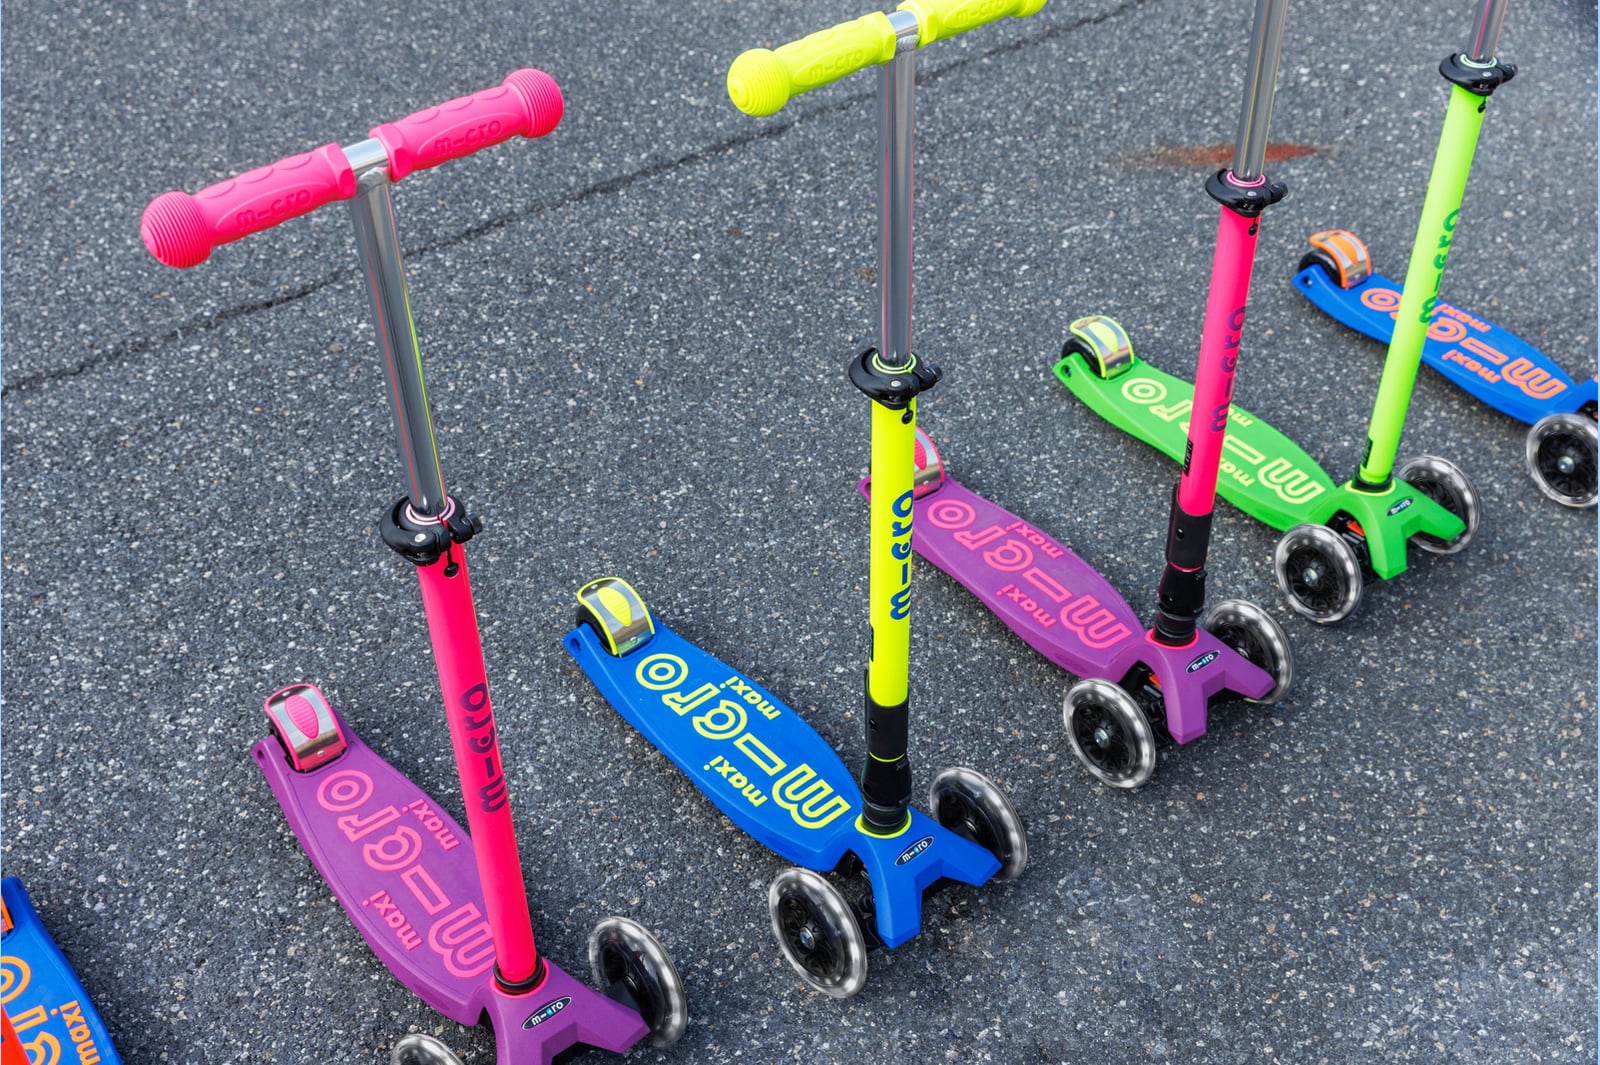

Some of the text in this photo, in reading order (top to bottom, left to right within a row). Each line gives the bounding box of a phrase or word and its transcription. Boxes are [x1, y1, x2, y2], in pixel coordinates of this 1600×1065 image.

[1442, 349, 1501, 383] maxi
[1006, 521, 1064, 559] maxi
[996, 583, 1057, 629] maxi
[720, 675, 781, 720] maxi
[704, 755, 767, 807] maxi
[401, 798, 460, 851] maxi
[361, 889, 423, 951] maxi
[50, 1000, 101, 1065] maxi
